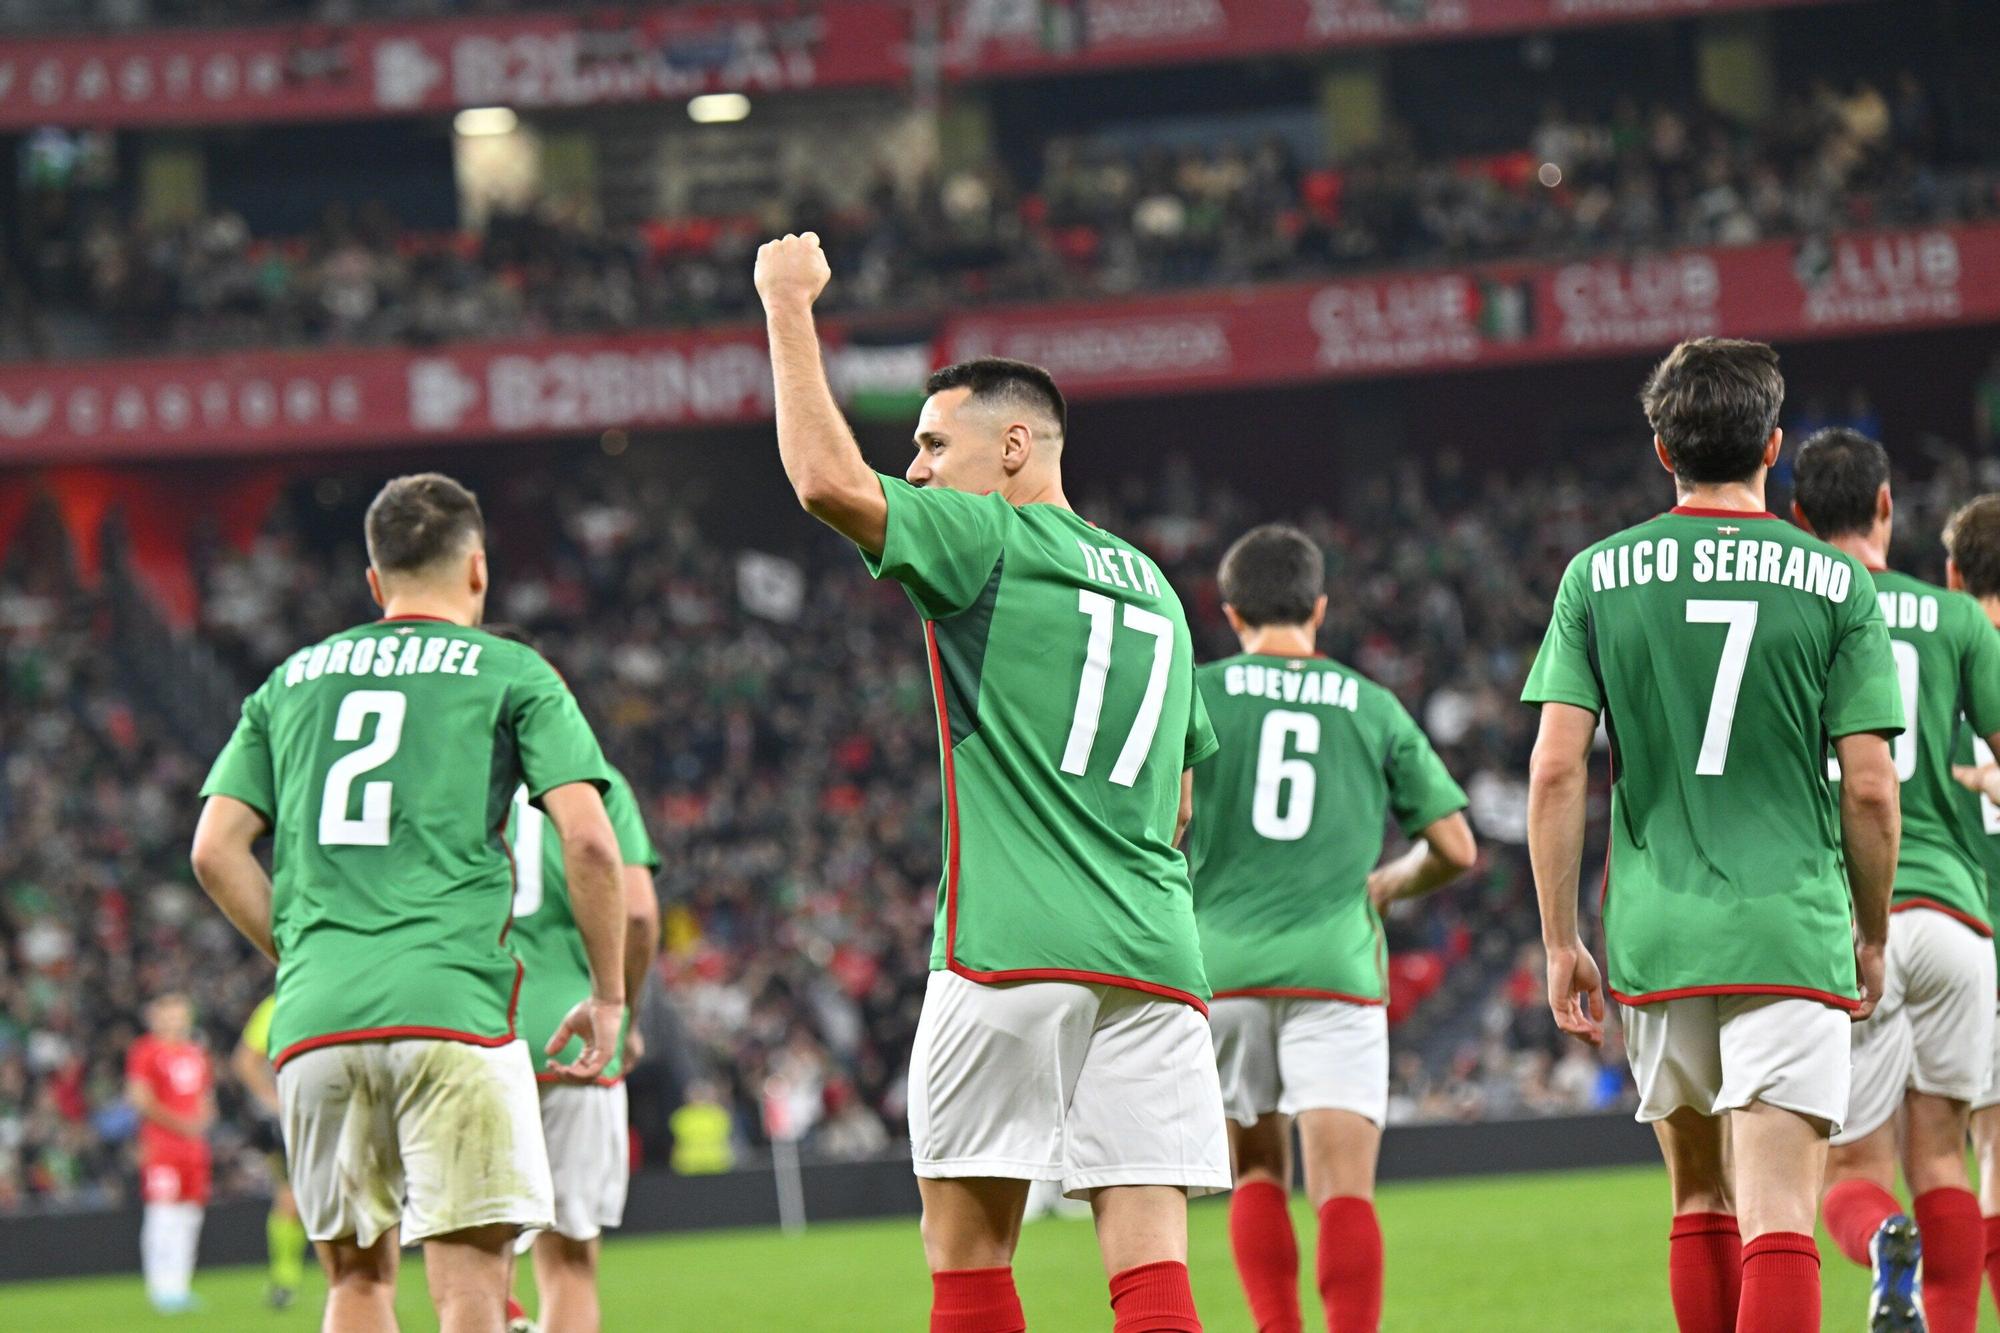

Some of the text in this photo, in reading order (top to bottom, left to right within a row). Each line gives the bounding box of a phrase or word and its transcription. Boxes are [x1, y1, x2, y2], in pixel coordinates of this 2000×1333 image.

[1591, 538, 1851, 603] NICO SERRANO
[1877, 591, 1938, 633] NDO
[285, 636, 483, 687] GOROSABEL
[1060, 589, 1174, 788] 17
[1224, 665, 1358, 711] GUEVARA
[1685, 599, 1759, 776] 7
[318, 690, 407, 846] 2
[1252, 709, 1320, 841] 6
